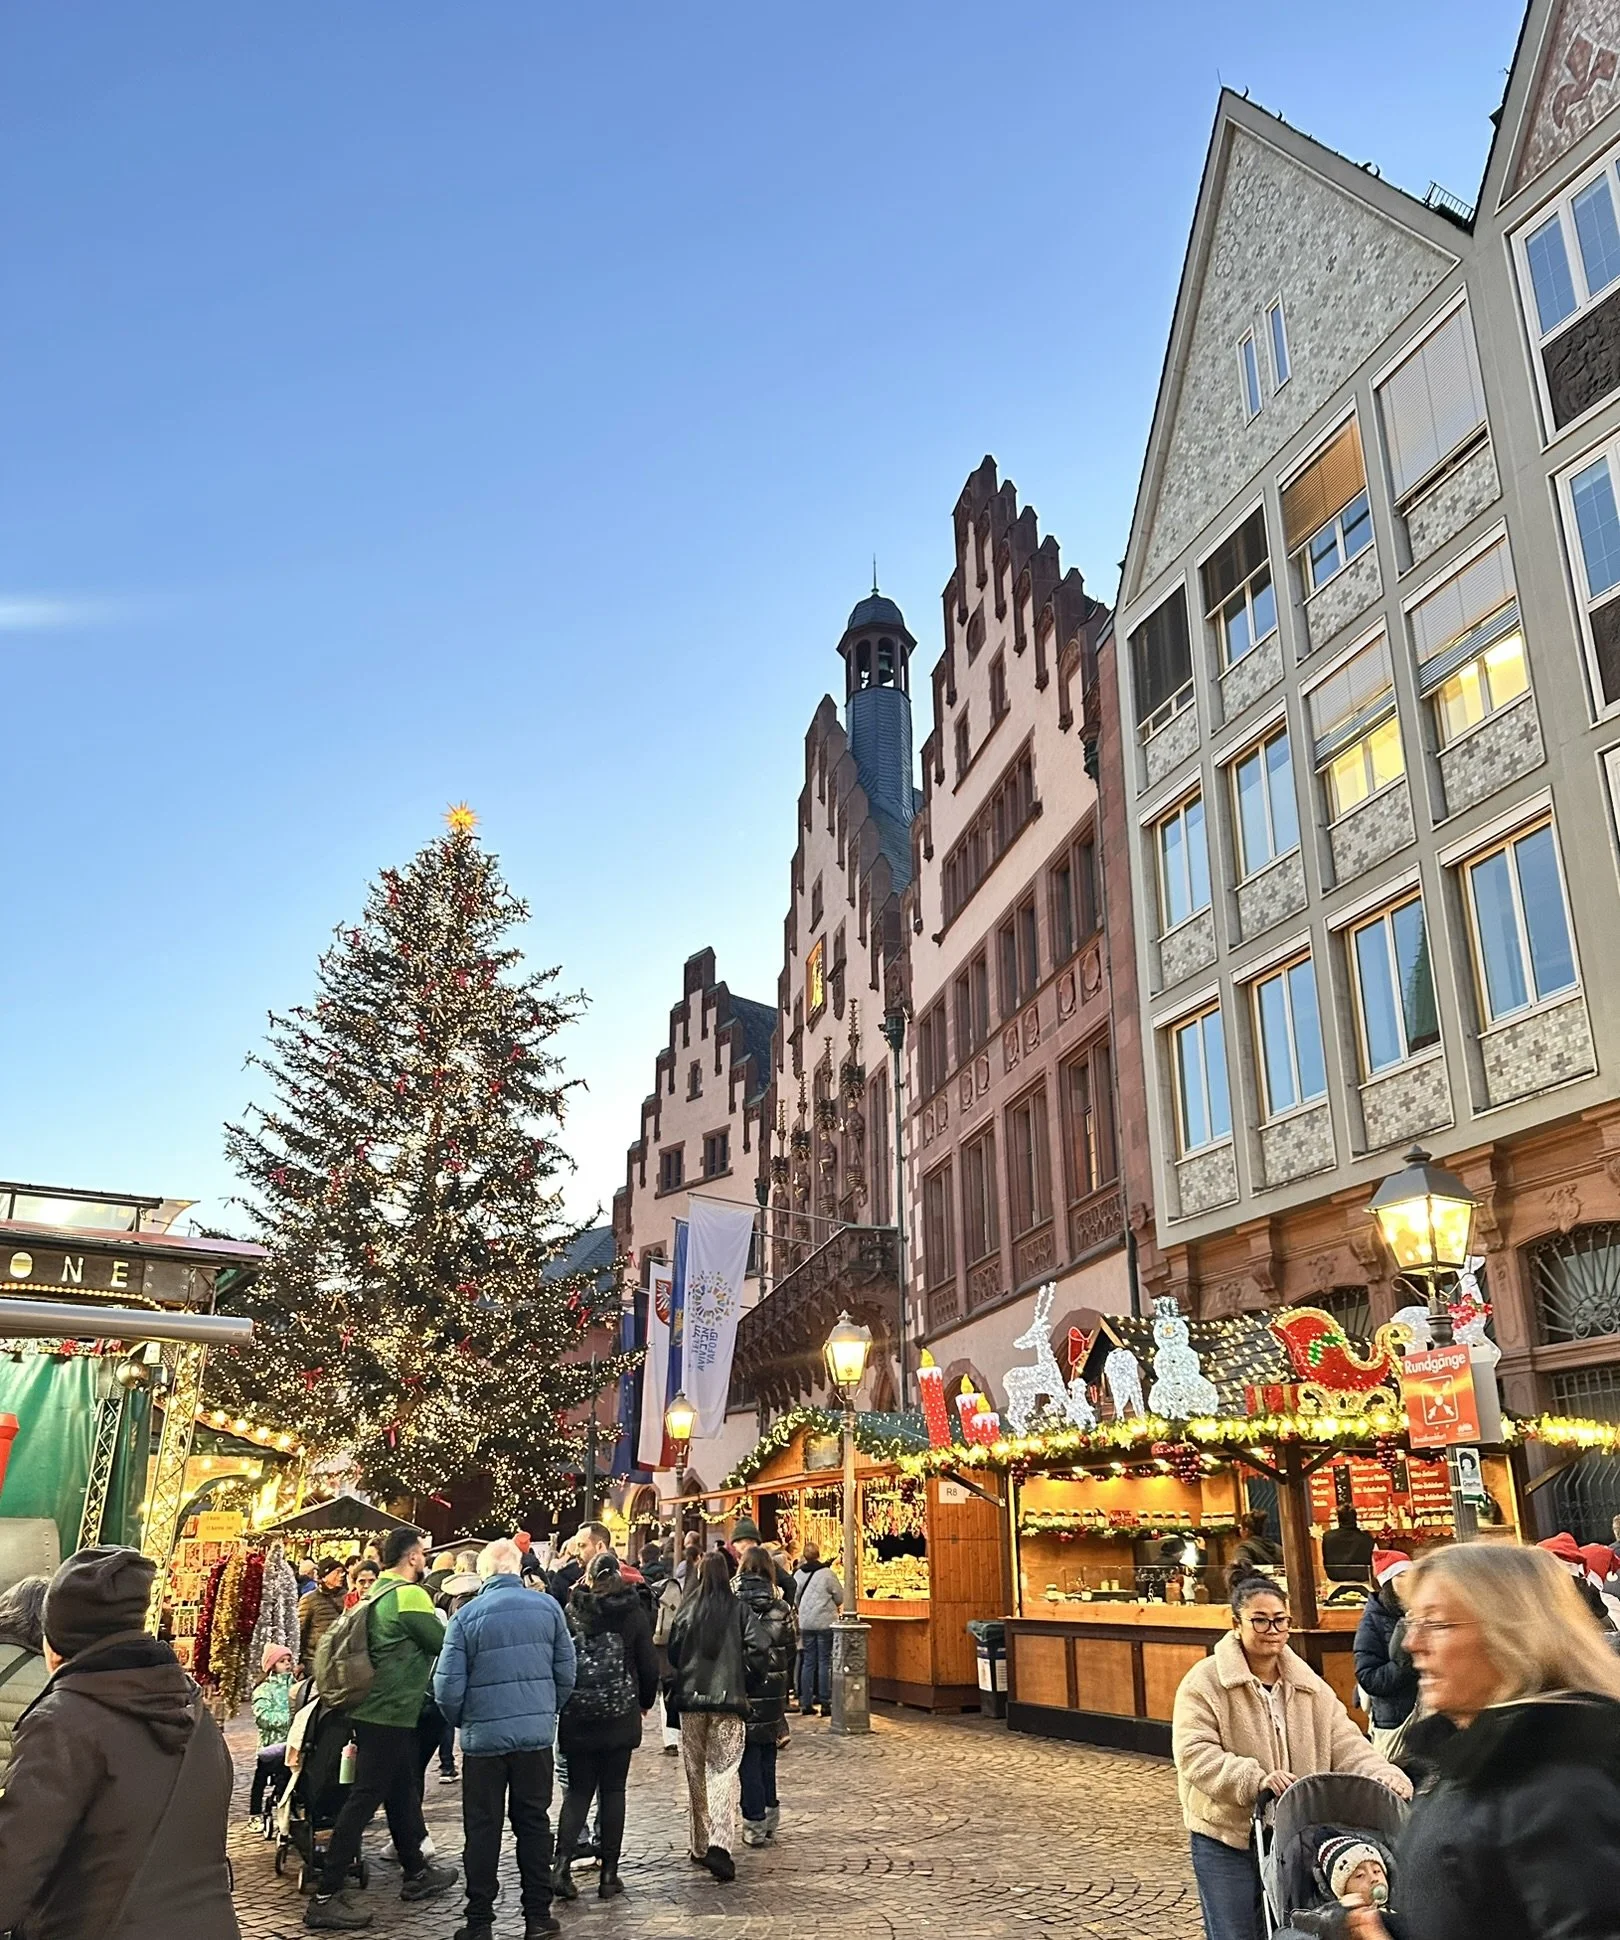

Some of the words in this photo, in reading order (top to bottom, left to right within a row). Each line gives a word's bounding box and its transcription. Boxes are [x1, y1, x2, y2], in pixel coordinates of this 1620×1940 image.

[697, 1350, 706, 1371] AVIV
[706, 1342, 717, 1365] YAFO
[1404, 1352, 1467, 1375] Rundgänge
[946, 1487, 958, 1496] R8
